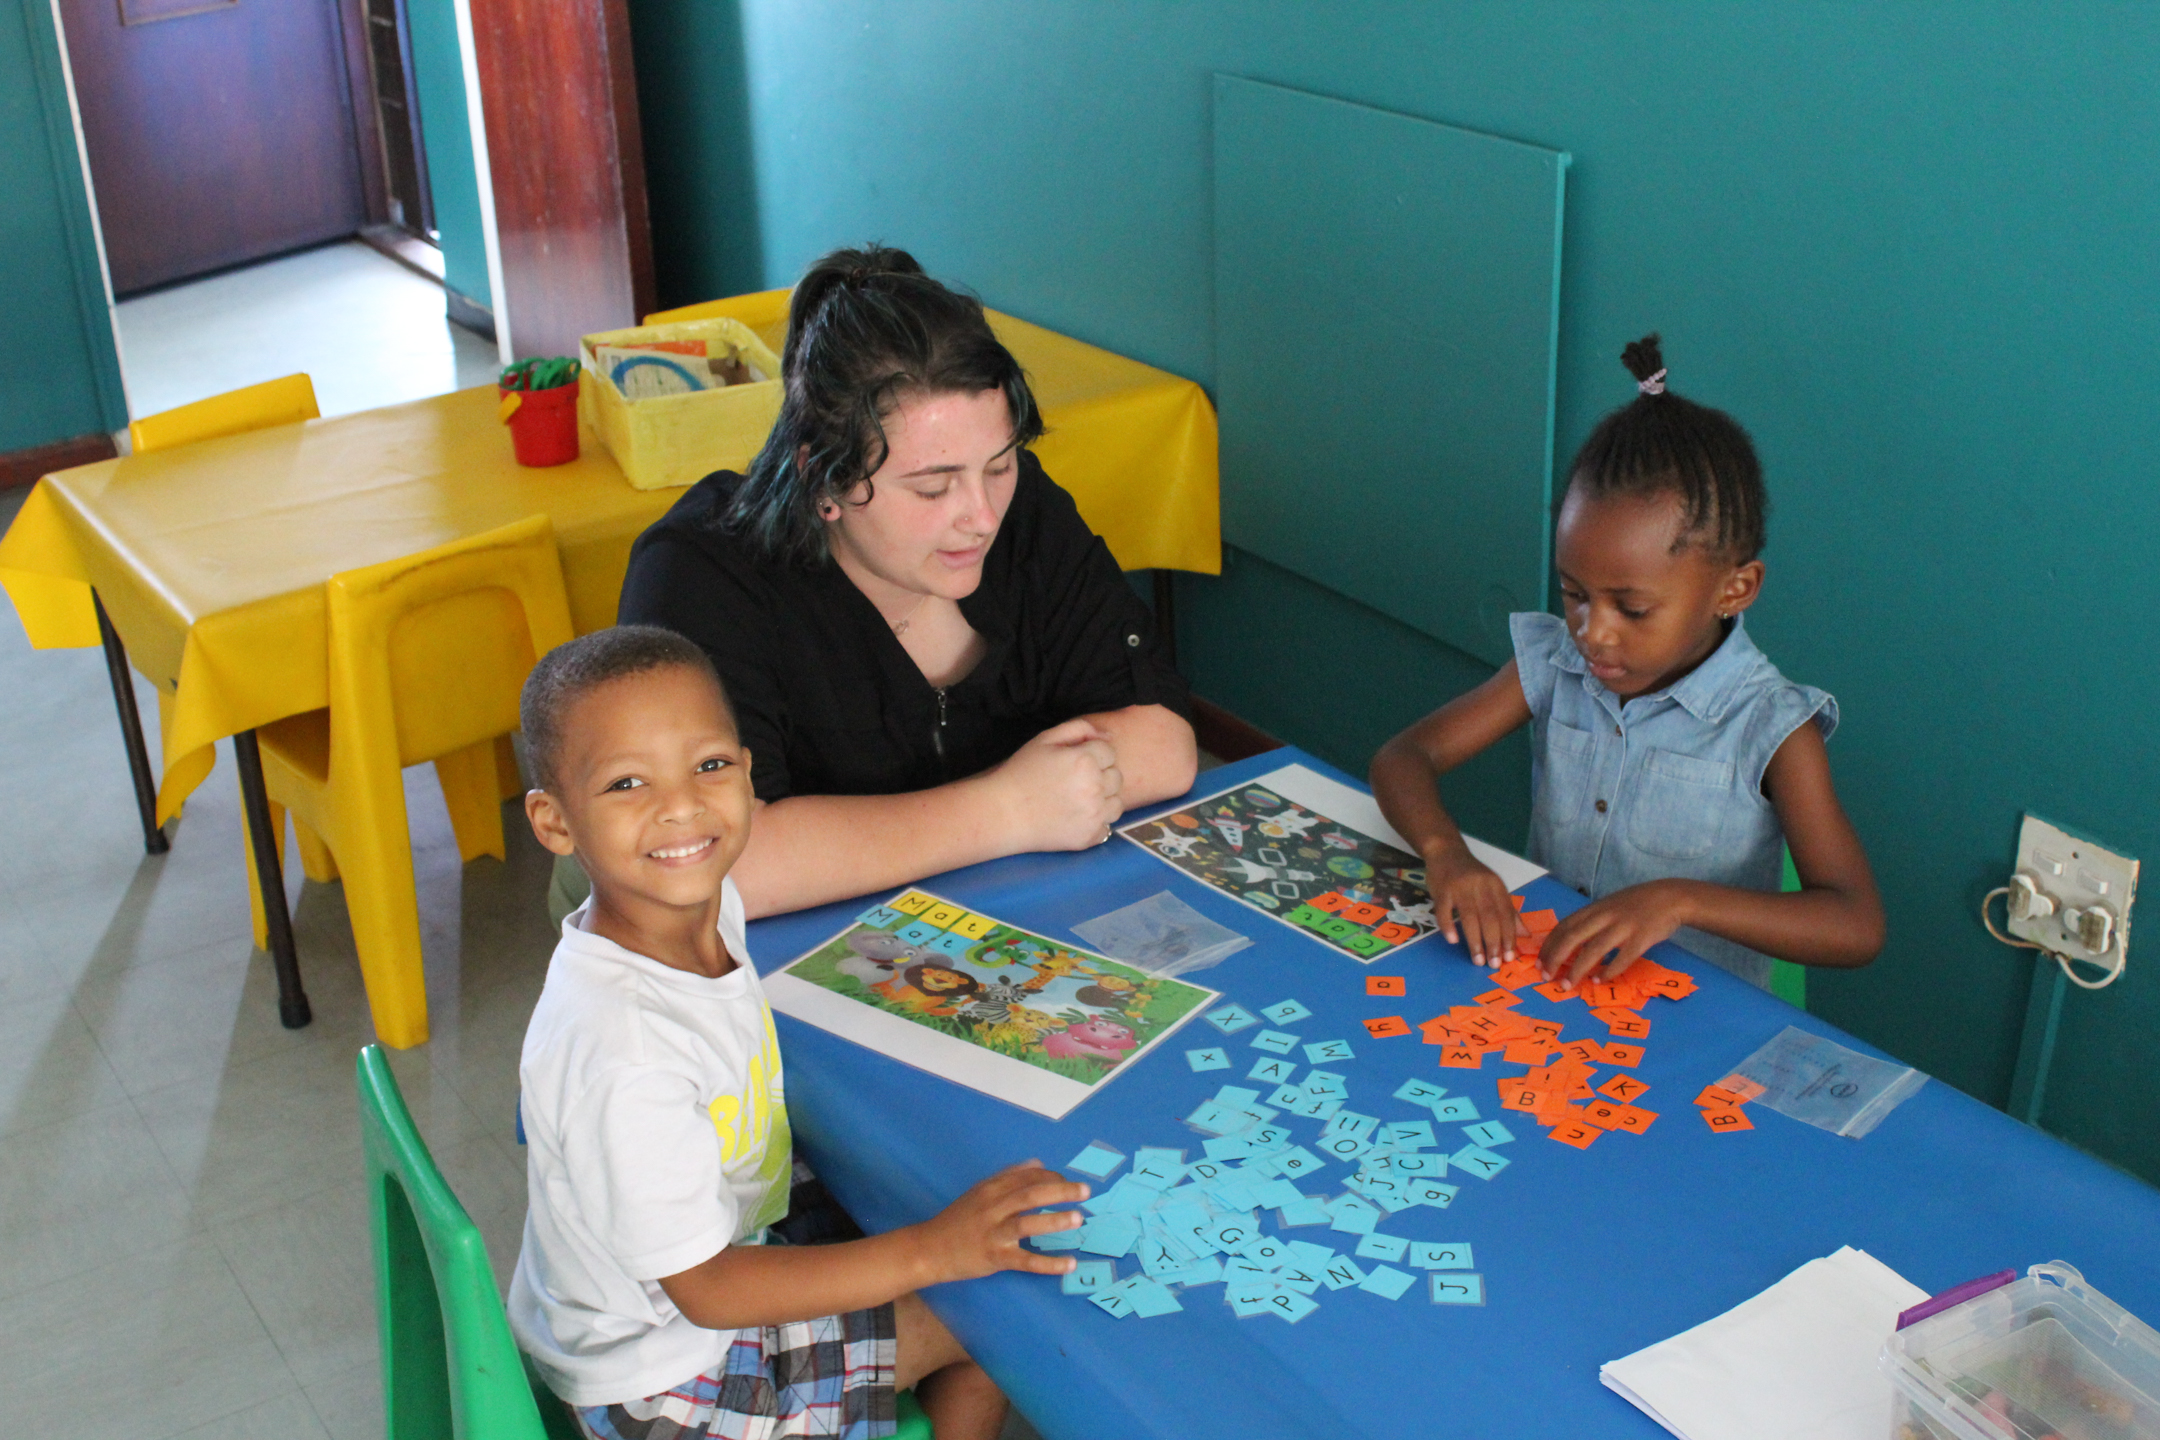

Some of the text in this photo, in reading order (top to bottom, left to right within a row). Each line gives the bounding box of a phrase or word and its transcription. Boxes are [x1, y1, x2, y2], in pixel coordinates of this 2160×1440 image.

[1262, 1063, 1279, 1076] A
[1612, 1081, 1637, 1096] K
[1519, 1092, 1536, 1105] B
[1713, 1114, 1738, 1126] B
[1220, 1228, 1244, 1244] G
